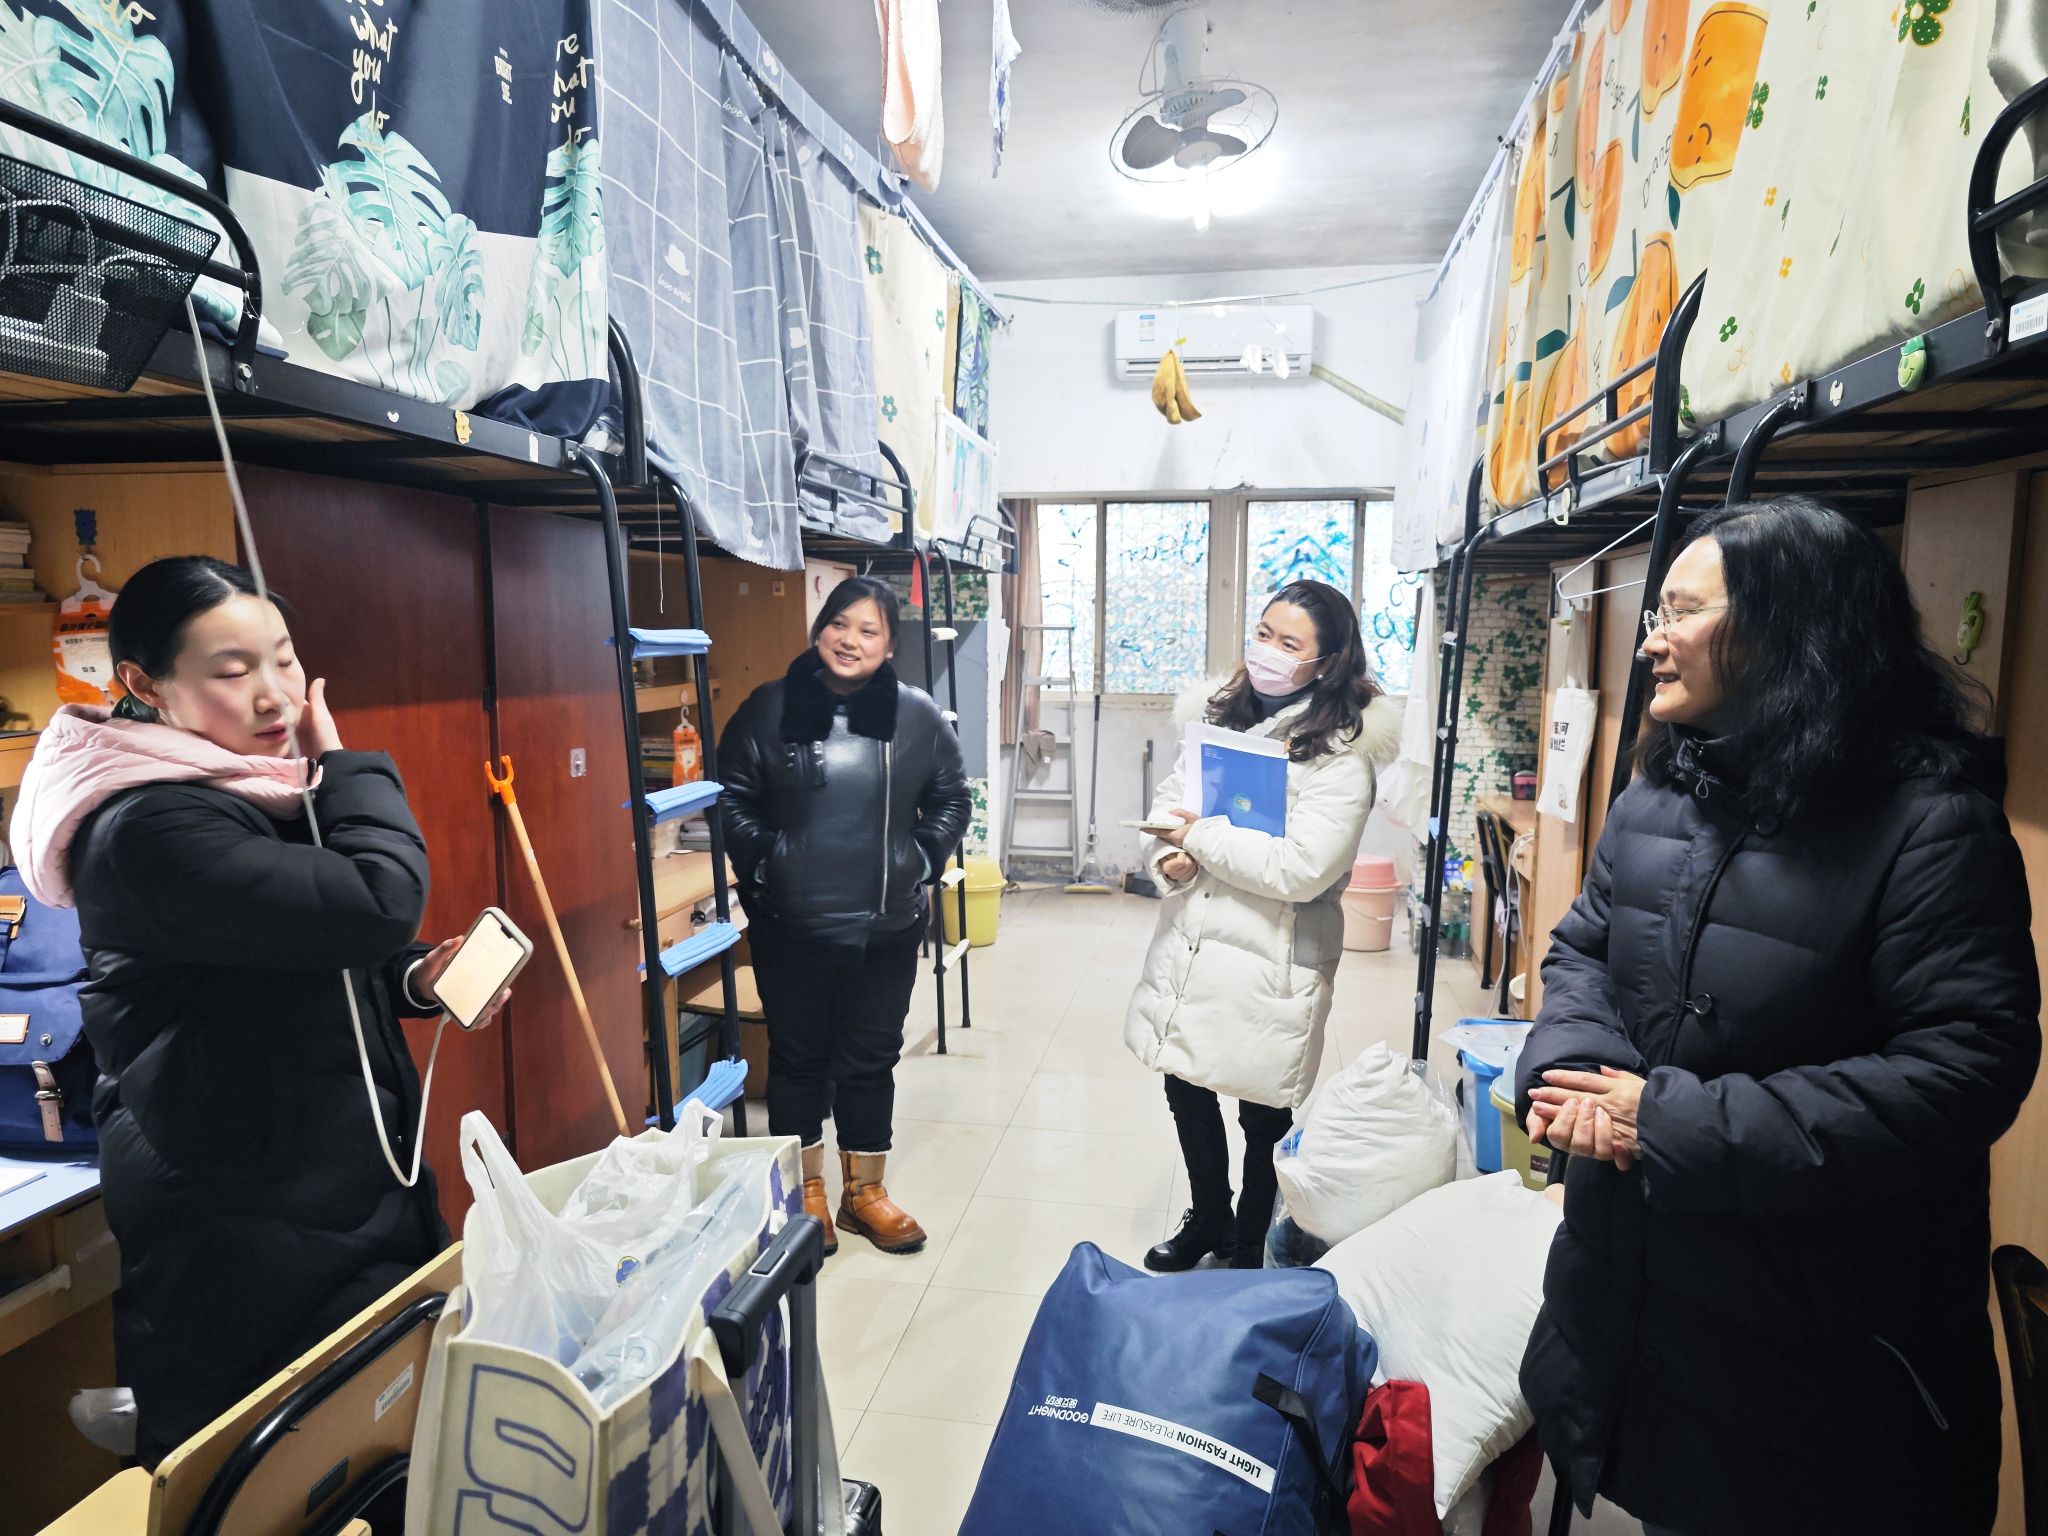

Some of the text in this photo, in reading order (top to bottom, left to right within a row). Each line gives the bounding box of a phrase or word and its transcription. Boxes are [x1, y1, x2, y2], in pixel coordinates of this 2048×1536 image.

[351, 49, 382, 105] you
[1028, 1405, 1089, 1424] GOODNIGHT
[1102, 1409, 1262, 1478] LIGHT FASHION PLEASURE LIFE
